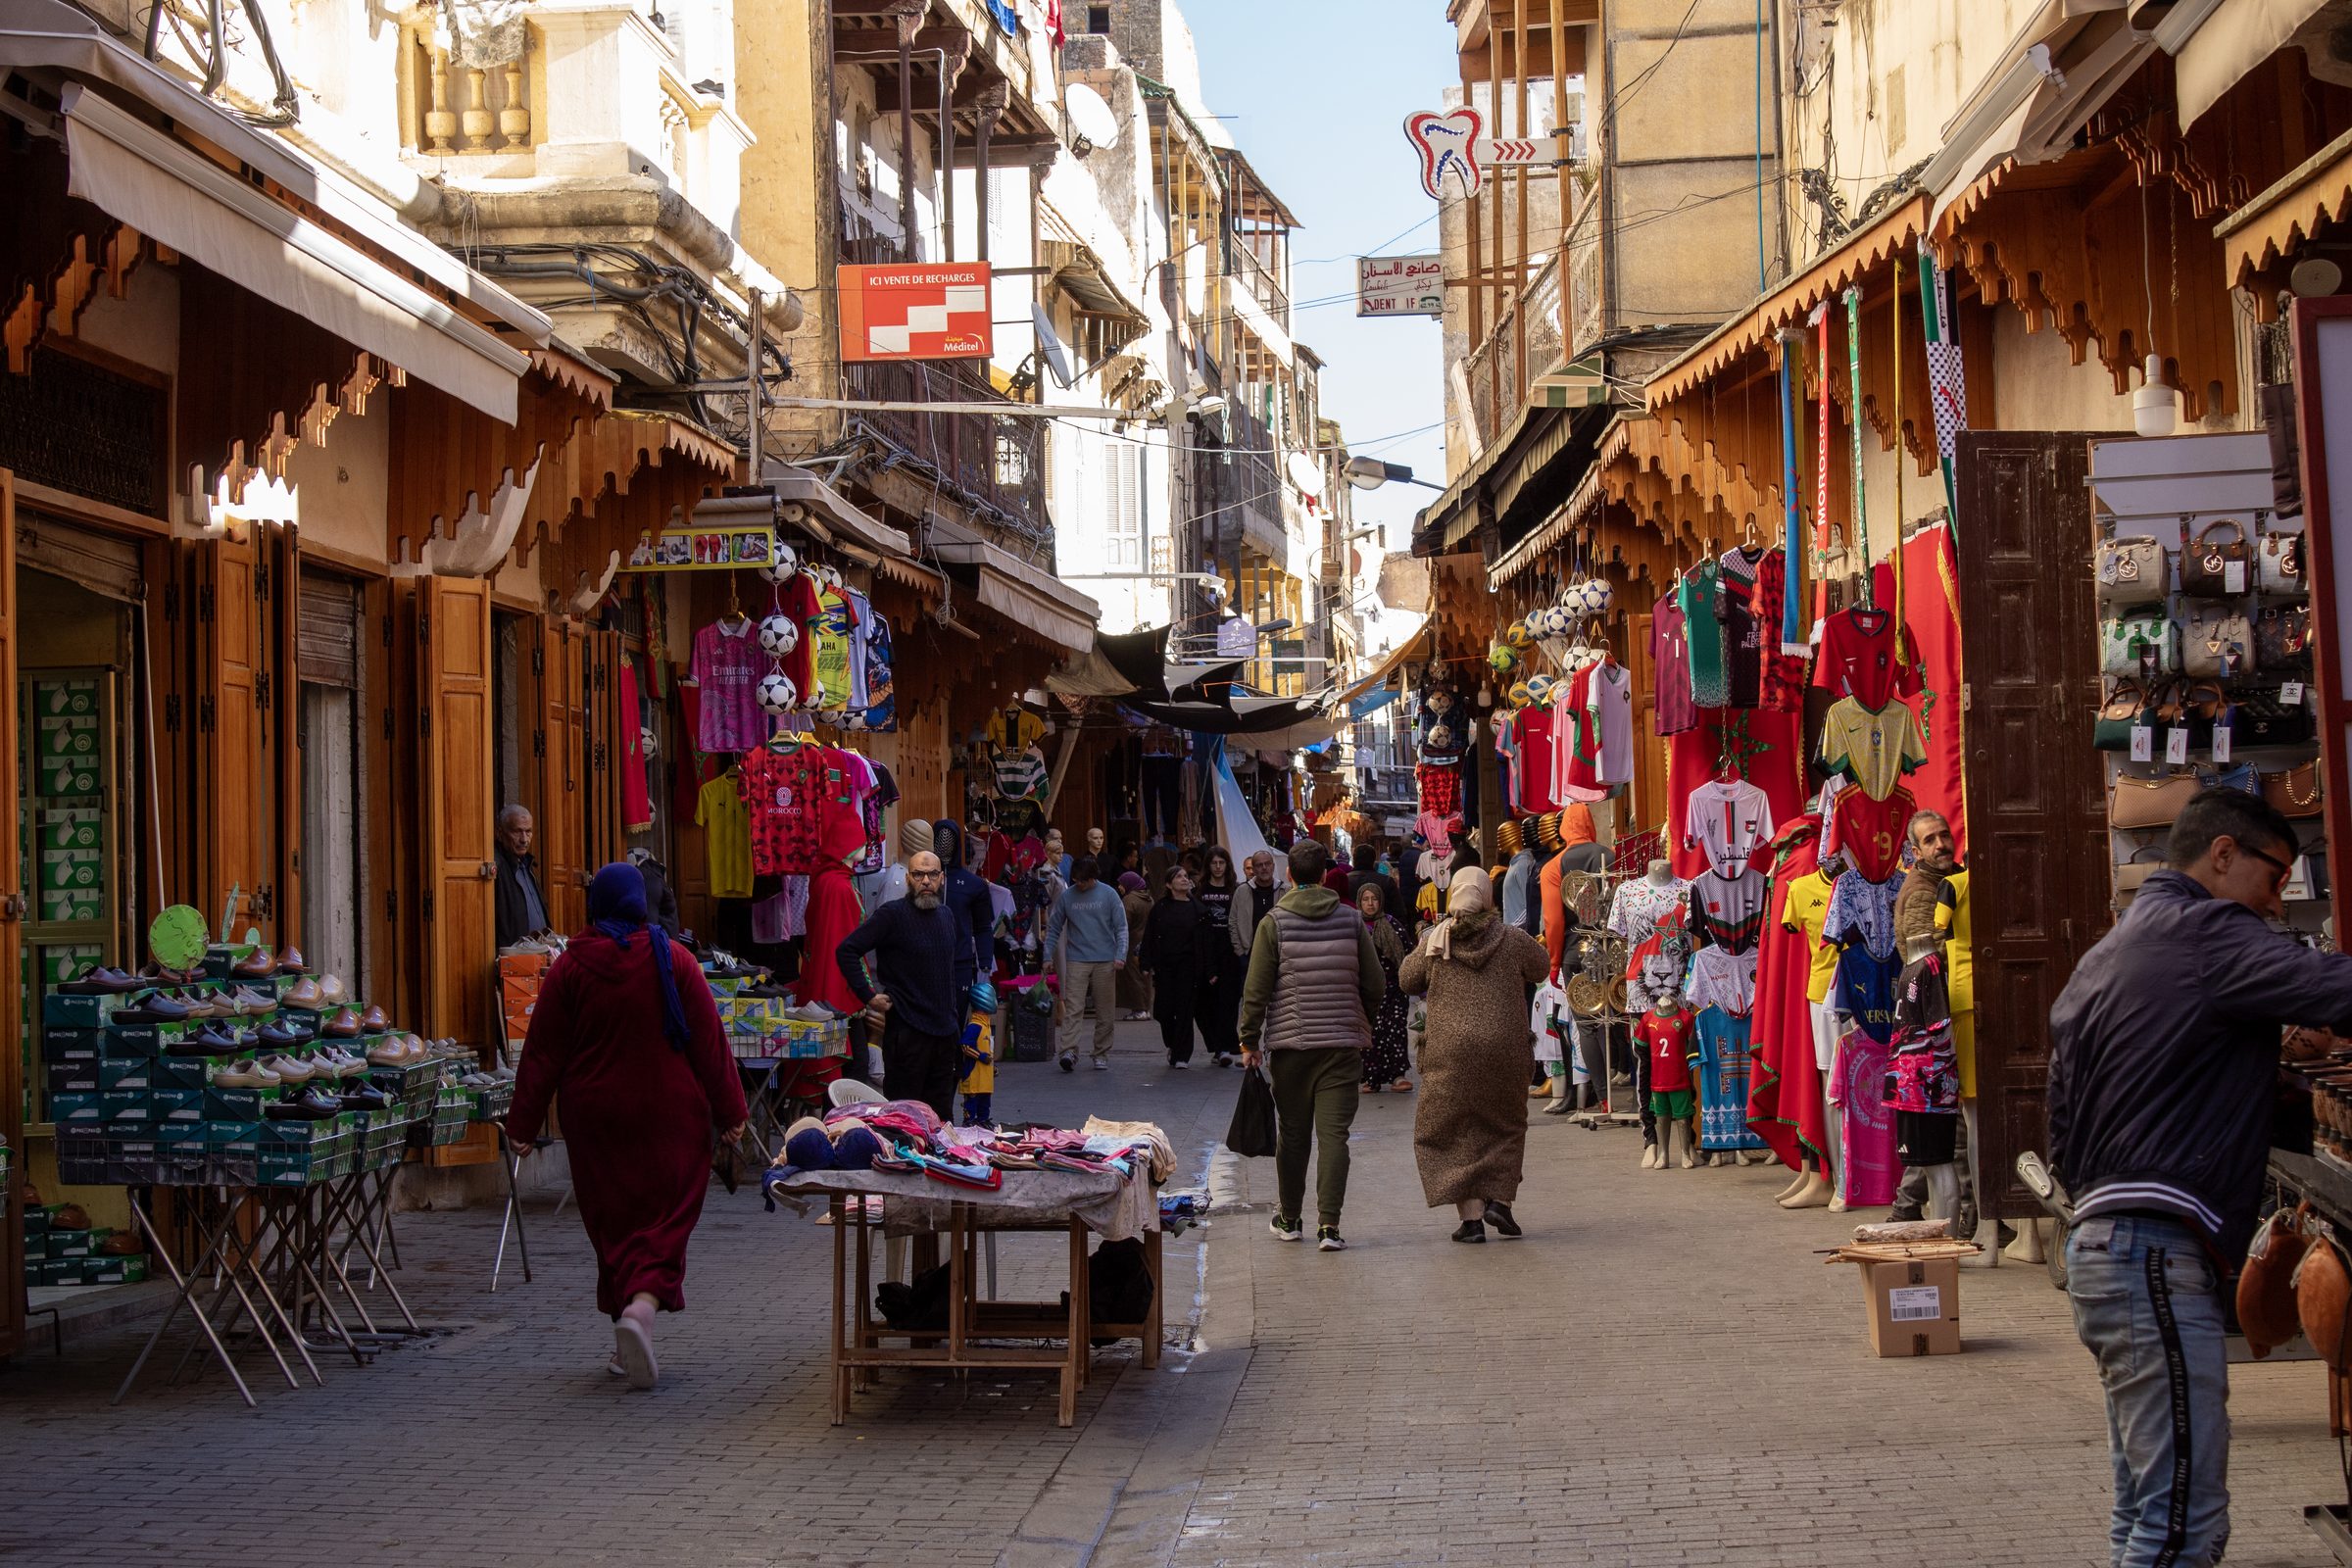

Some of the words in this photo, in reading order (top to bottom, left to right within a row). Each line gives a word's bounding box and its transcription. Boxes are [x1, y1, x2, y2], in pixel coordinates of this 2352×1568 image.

[1405, 261, 1441, 276] صانع
[870, 276, 882, 286] ICI
[884, 275, 910, 285] VENTE
[912, 274, 924, 284] DE
[925, 272, 975, 284] RECHARGES
[1374, 298, 1396, 310] DENT
[944, 341, 978, 352] Méditel
[1818, 404, 1827, 526] MOROCCO
[713, 665, 755, 676] Emirates
[1873, 831, 1892, 860] 19
[1864, 1009, 1895, 1024] VERSA
[1659, 1039, 1669, 1057] 2
